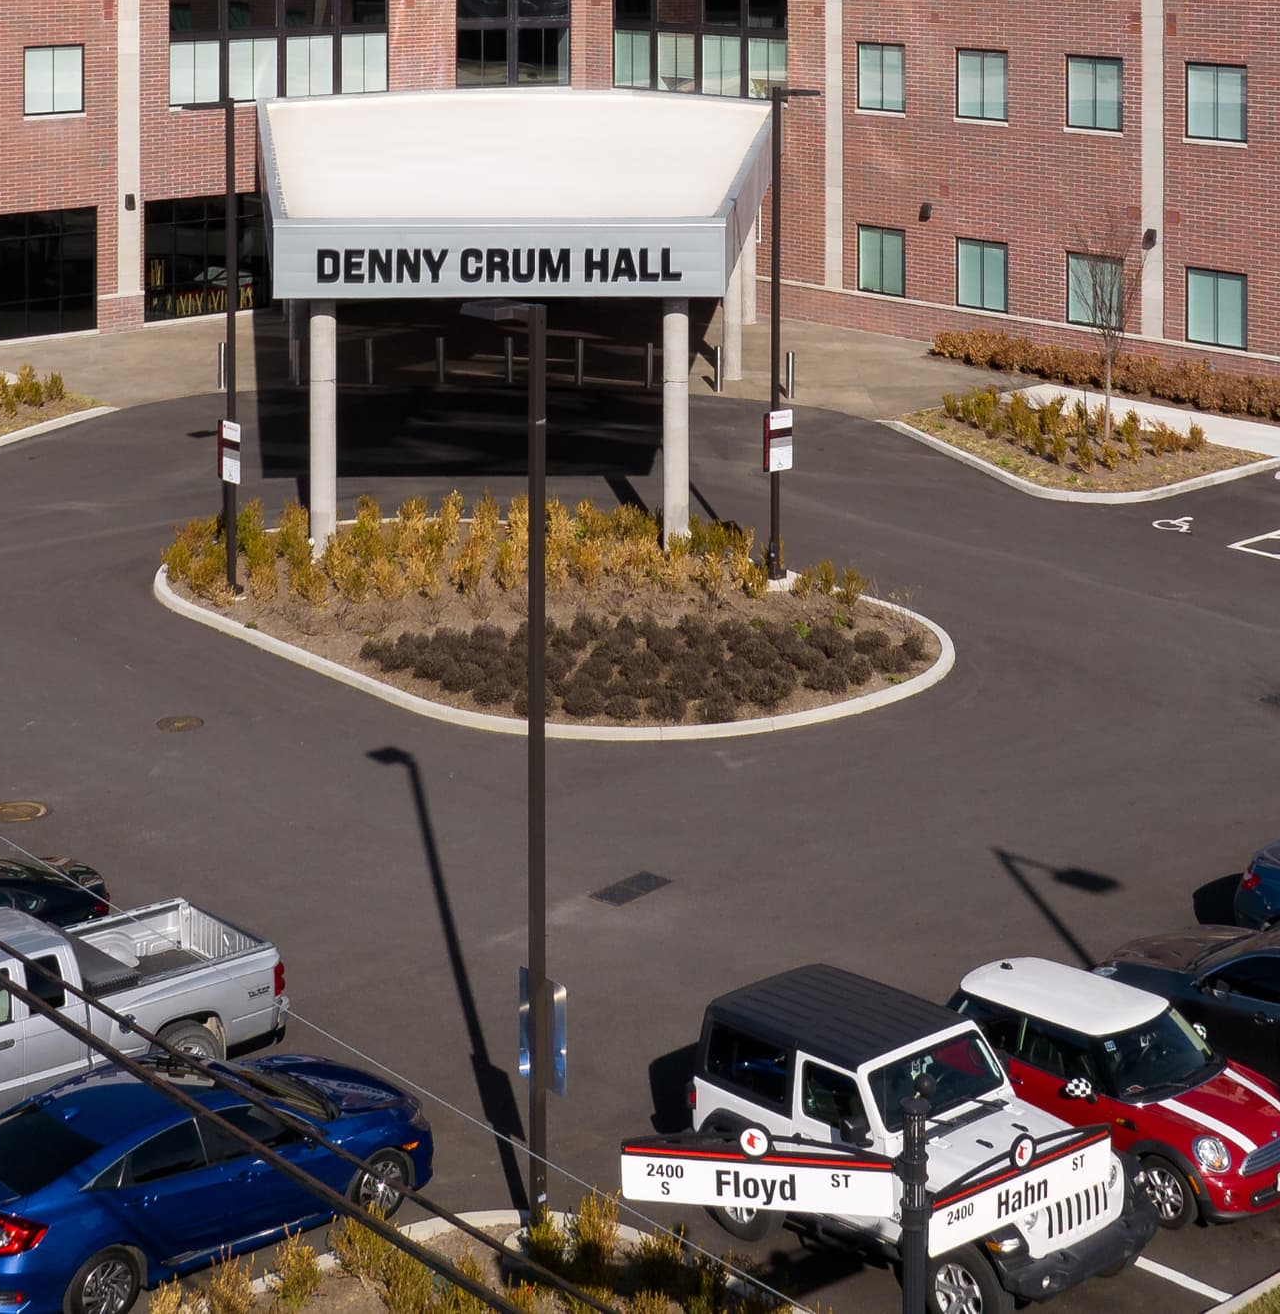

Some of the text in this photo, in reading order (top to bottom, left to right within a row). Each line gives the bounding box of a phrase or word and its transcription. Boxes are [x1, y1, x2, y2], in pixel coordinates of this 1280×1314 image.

[317, 247, 683, 283] DENNY CRUM HALL
[646, 1163, 852, 1205] 2400 Floyd ST
[660, 1181, 671, 1196] S
[947, 1153, 1086, 1226] 2400 Hahn ST
